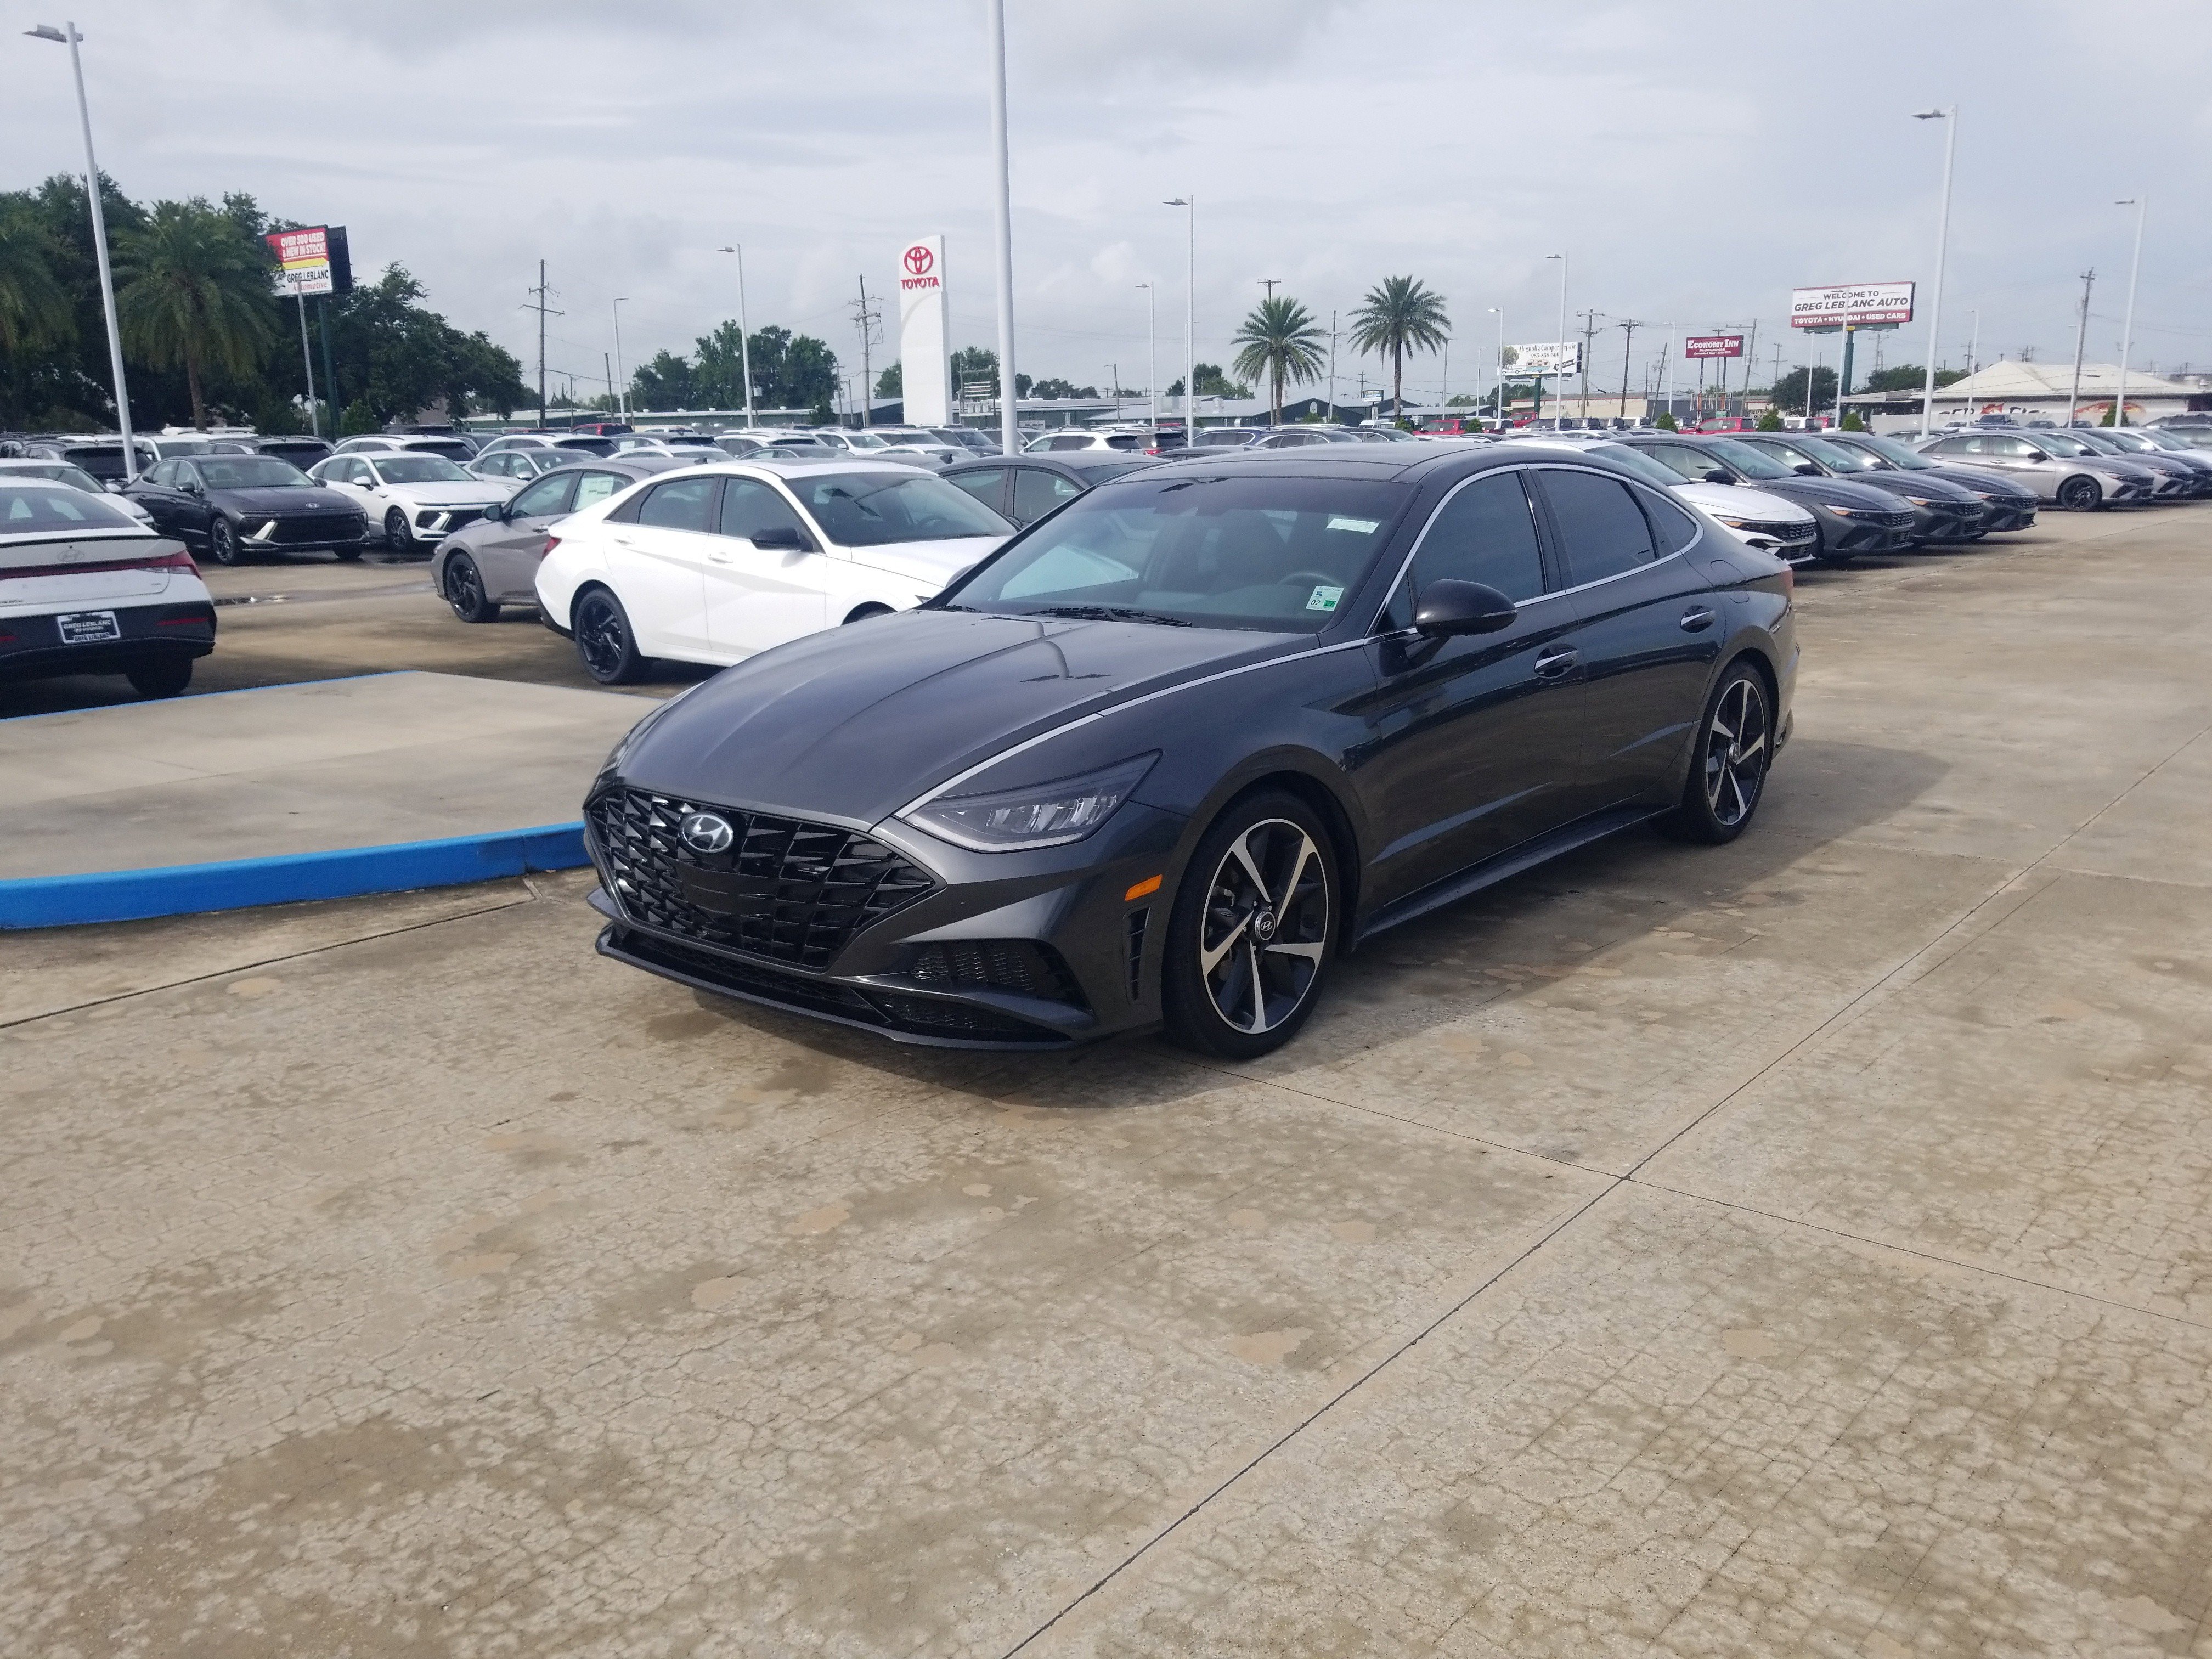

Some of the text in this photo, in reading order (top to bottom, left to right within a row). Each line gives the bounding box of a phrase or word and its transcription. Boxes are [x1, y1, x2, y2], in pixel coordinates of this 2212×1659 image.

[281, 232, 325, 247] OVER 500 USED
[286, 246, 300, 257] NEW
[300, 245, 306, 256] IN
[306, 242, 326, 254] STOCK!
[293, 281, 328, 291] Atomotive
[900, 276, 940, 290] TOYOTA
[1824, 290, 1865, 300] WELCOME
[1794, 297, 1908, 312] GREG LEBANC AUTO
[1828, 313, 1860, 323] HYUDAI
[1687, 338, 1739, 349] ECONOMY INN
